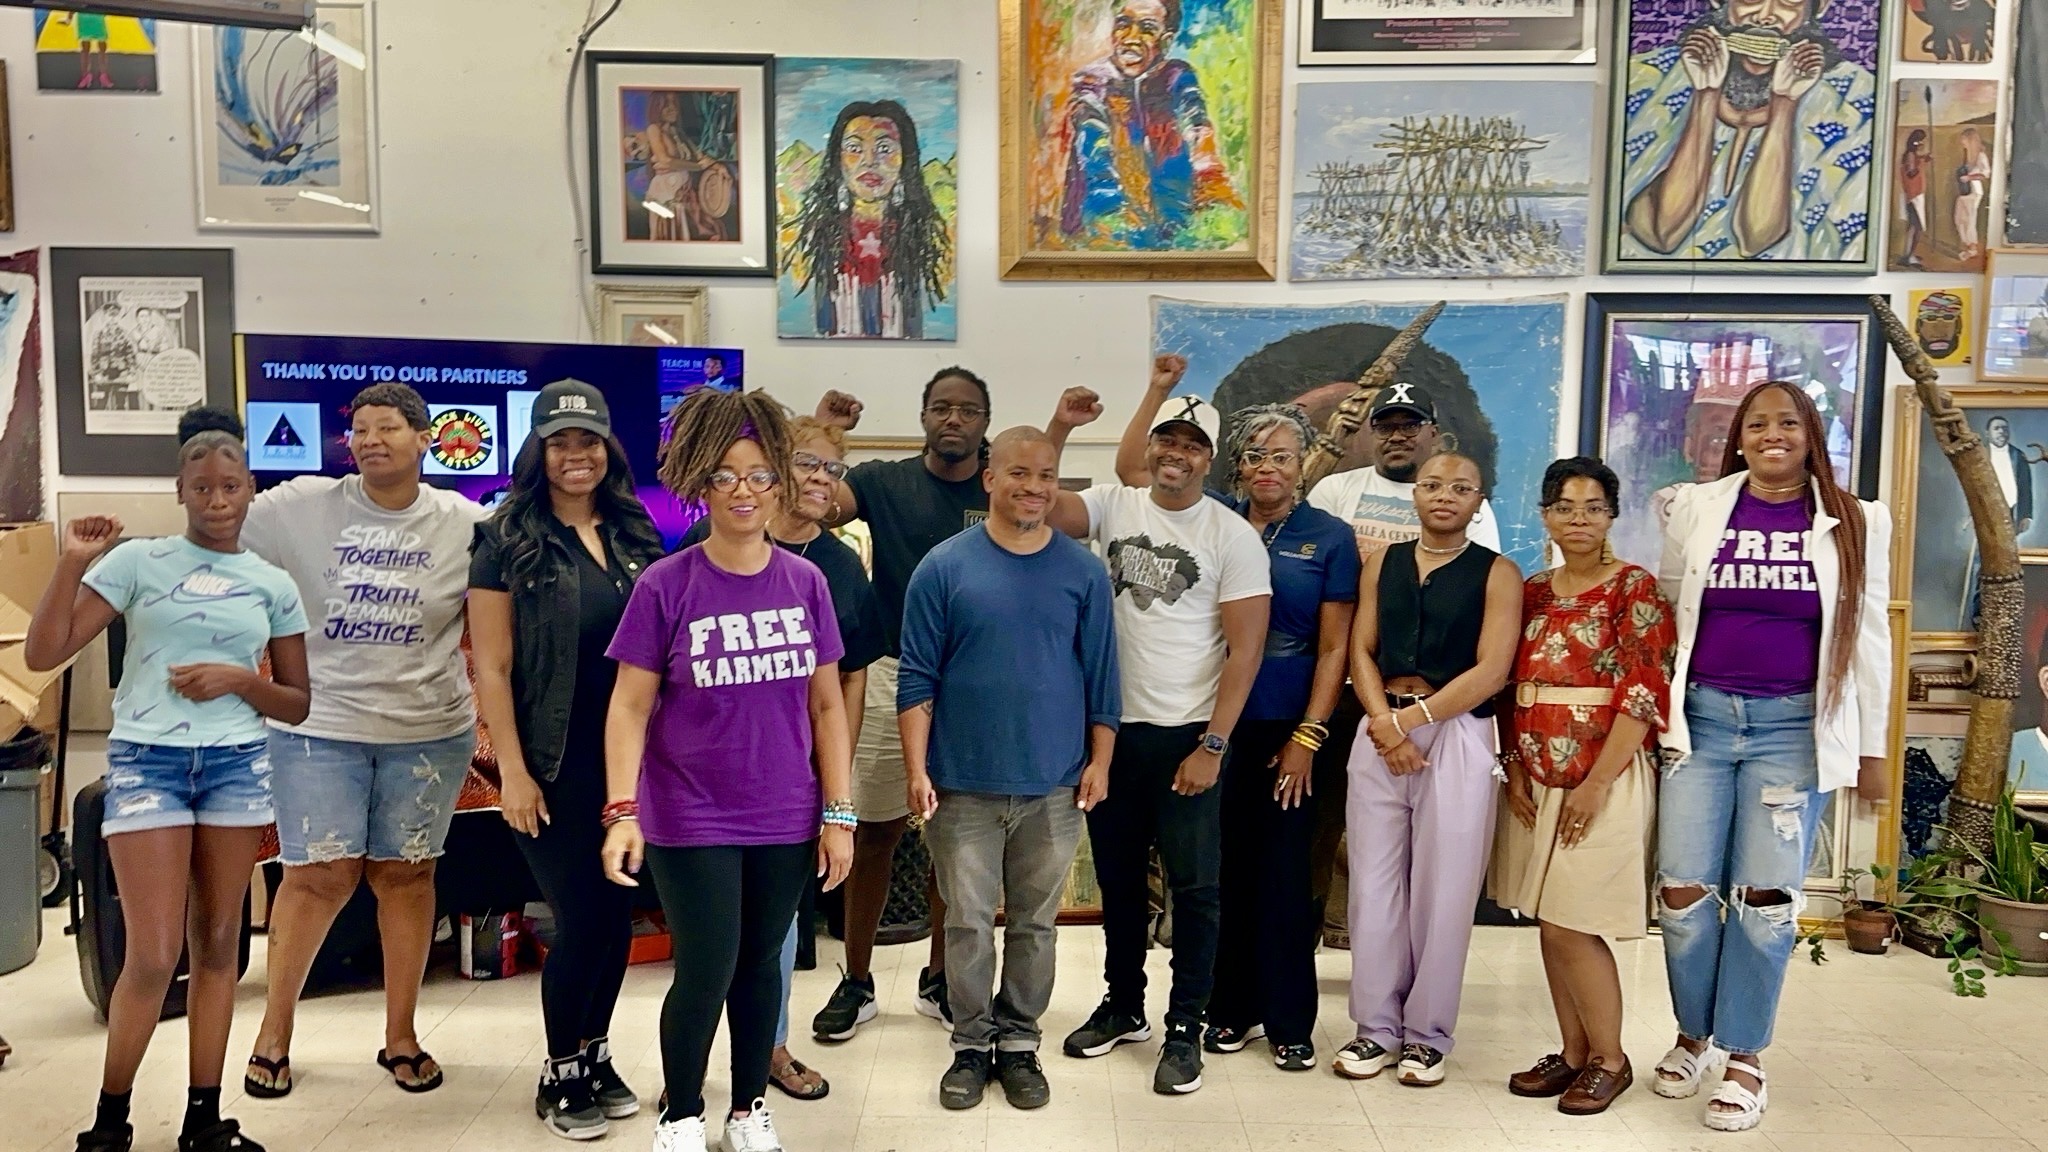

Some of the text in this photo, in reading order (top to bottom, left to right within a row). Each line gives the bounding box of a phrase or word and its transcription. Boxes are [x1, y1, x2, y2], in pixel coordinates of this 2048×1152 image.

[262, 362, 528, 385] THANK YOU TO OUR PARTNERS
[661, 359, 691, 368] TEACH
[1385, 382, 1415, 404] X
[1173, 396, 1204, 424] X
[463, 412, 492, 440] LIVES
[435, 450, 486, 469] MATTER
[336, 524, 421, 551] STAND
[1378, 529, 1387, 539] A
[333, 545, 435, 573] TOGETHER.
[182, 573, 234, 596] NIKE
[338, 565, 409, 588] SEEK
[343, 584, 424, 607] TRUTH.
[324, 598, 423, 624] DEMAND
[324, 618, 425, 645] JUSTICE.
[688, 606, 812, 657] FREE
[691, 648, 816, 688] KARMELO
